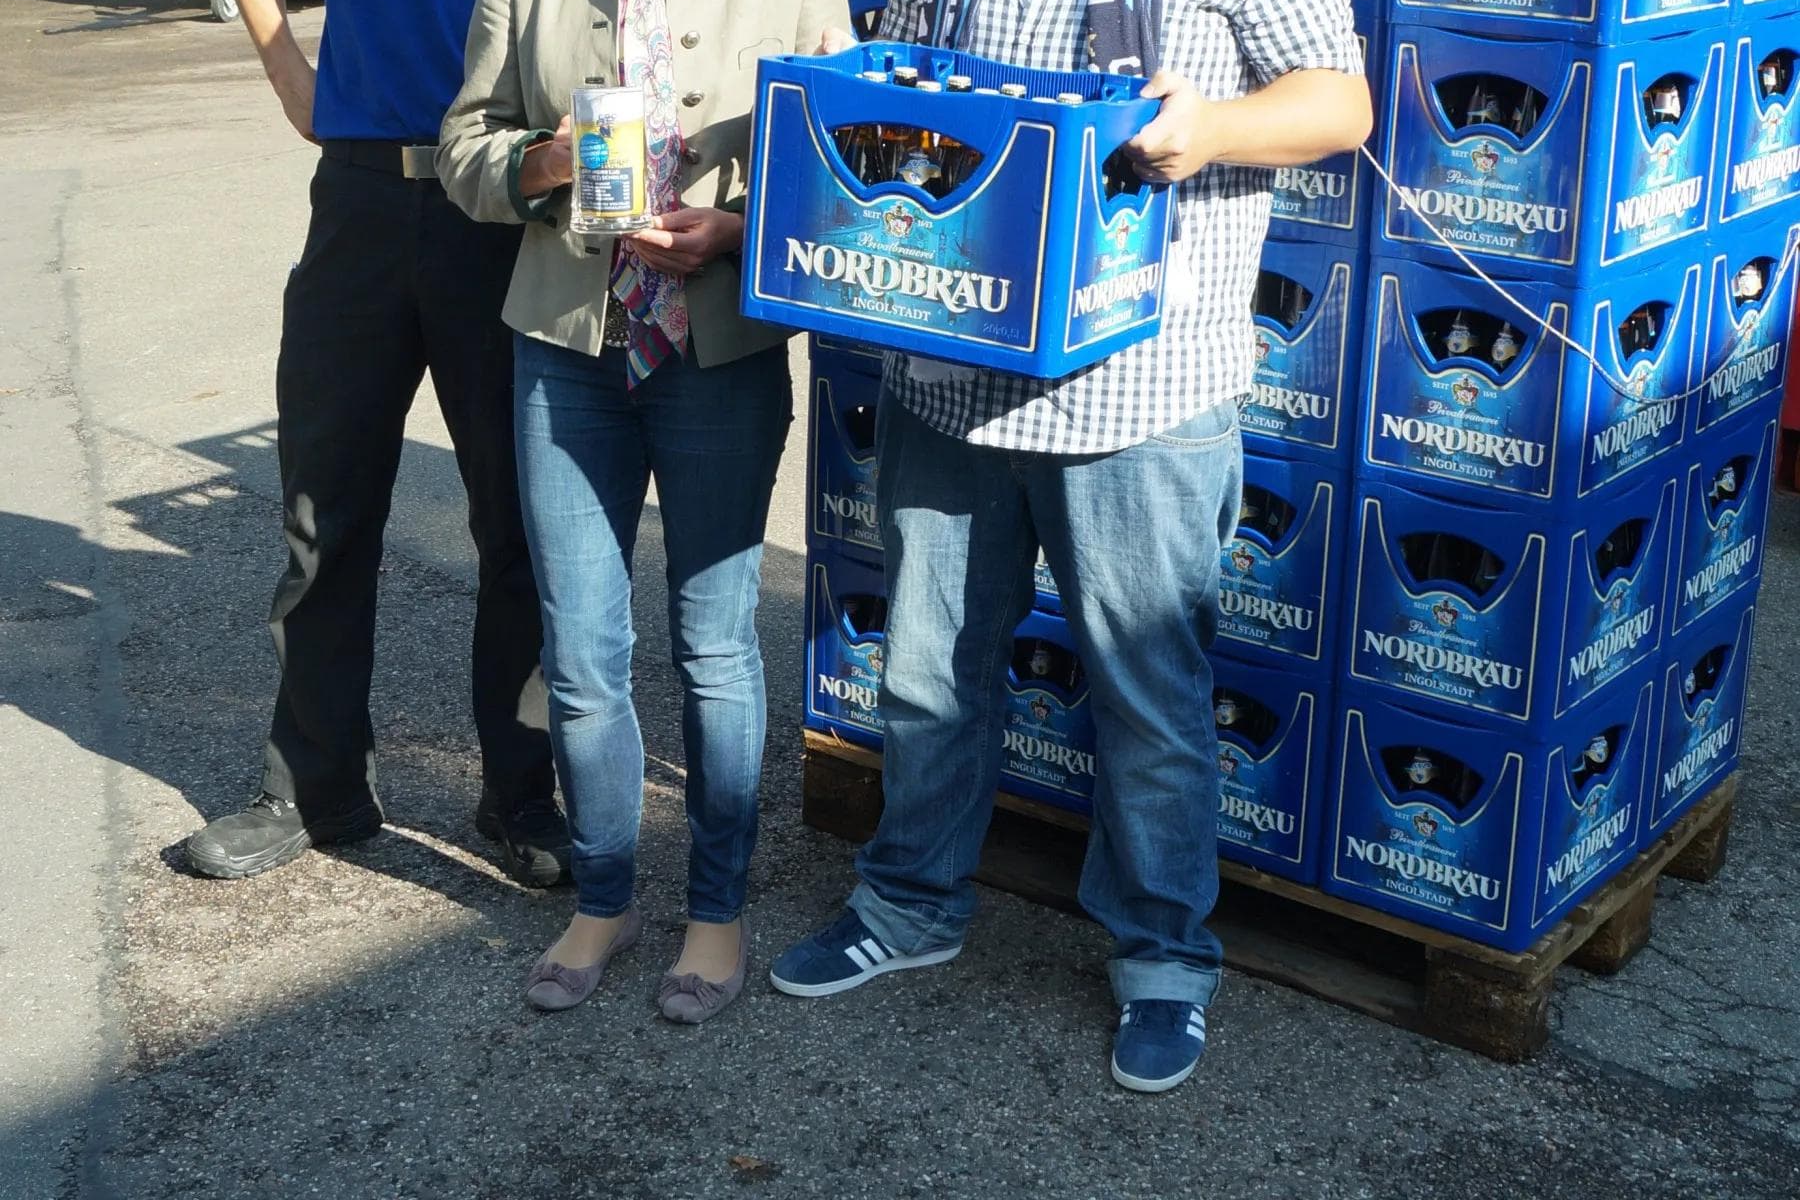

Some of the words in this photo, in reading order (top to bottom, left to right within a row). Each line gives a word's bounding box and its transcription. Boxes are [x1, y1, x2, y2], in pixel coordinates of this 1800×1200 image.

[1398, 186, 1568, 236] NORDBRÄU
[1442, 228, 1517, 248] INGOLSTADT
[784, 237, 1012, 314] NORDBRÄU
[1073, 263, 1160, 317] NORDBRÄU
[852, 297, 932, 322] INGOLSTADT
[1380, 413, 1545, 468] NORDBRÄU
[1591, 394, 1679, 464] NORDBRÄU
[1422, 455, 1496, 480] INGOLSTADT
[1683, 535, 1756, 606] NORDBRÄU
[1362, 629, 1523, 690] NORDBRÄU
[1568, 604, 1655, 686] NORDBRÄU
[1403, 671, 1475, 699] INGOLSTADT
[1009, 759, 1066, 784] INGOLSTADT
[1661, 718, 1734, 798] NORDBRÄU
[1345, 835, 1501, 901] NORDBRÄU
[1544, 803, 1631, 895] NORDBRÄU
[1385, 878, 1455, 907] INGOLSTADT
